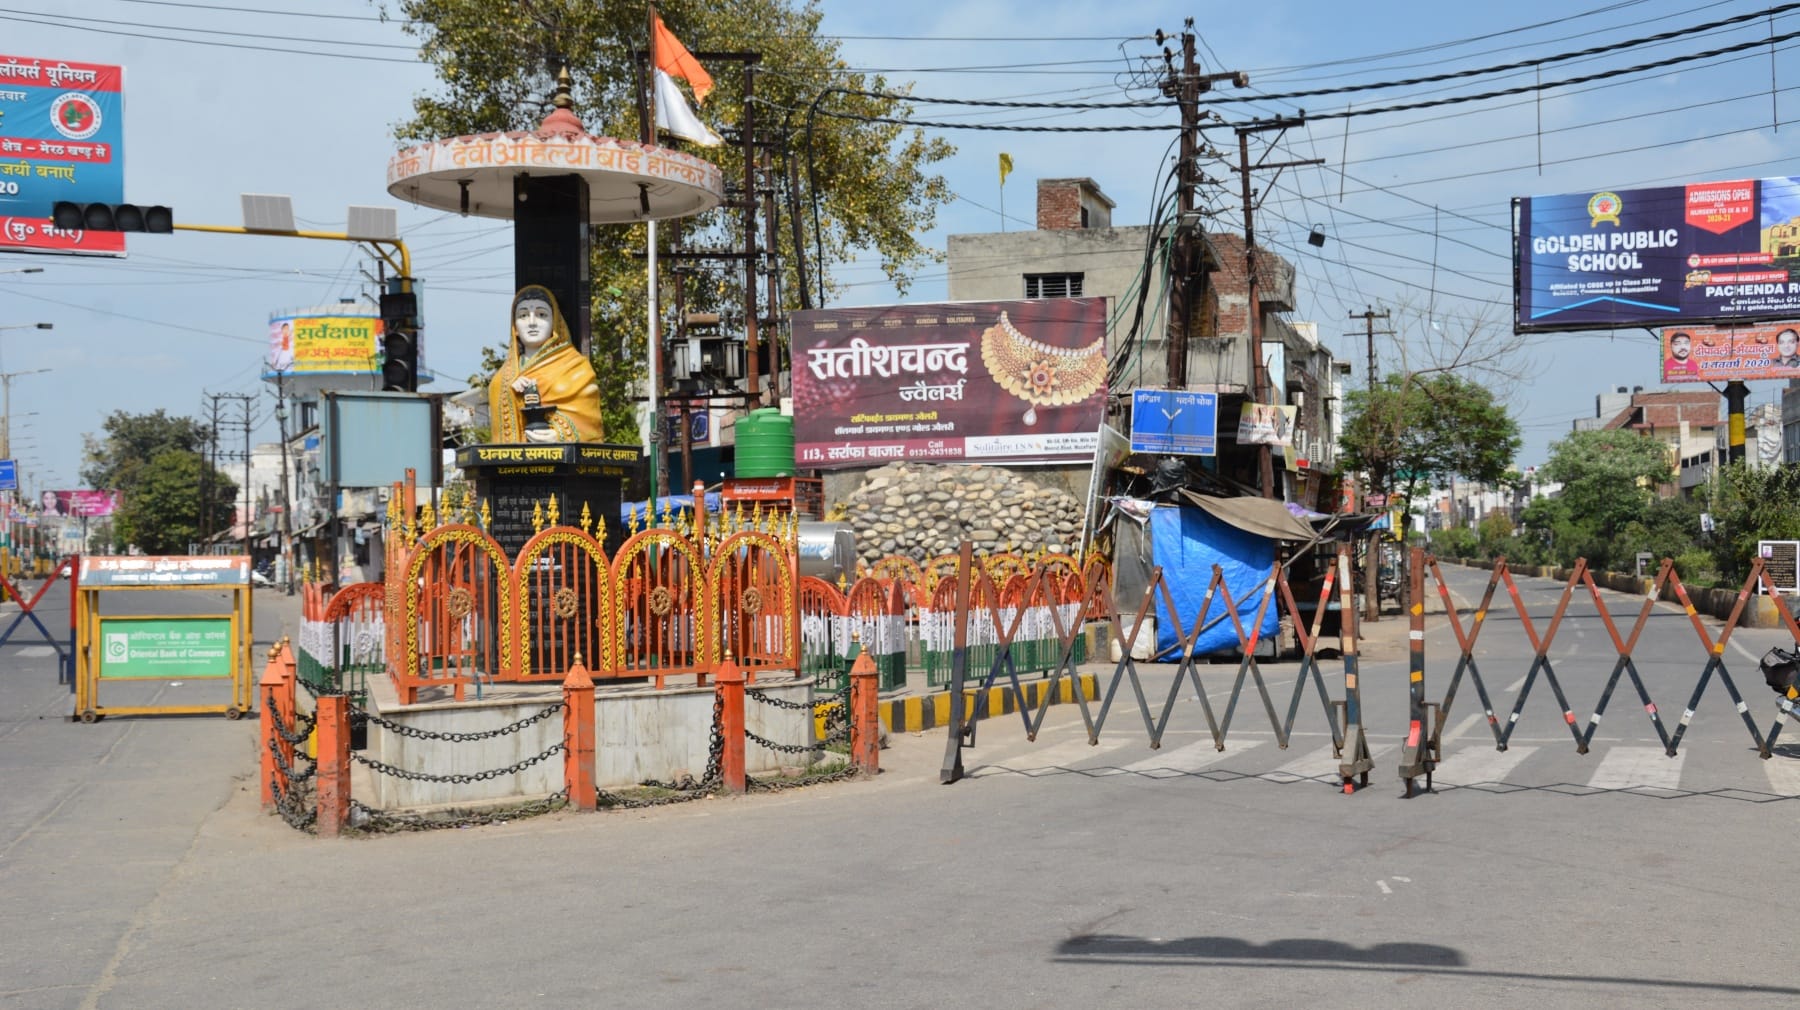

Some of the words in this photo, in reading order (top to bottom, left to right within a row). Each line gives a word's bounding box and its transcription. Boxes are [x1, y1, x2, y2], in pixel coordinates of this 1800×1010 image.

[46, 63, 97, 86] यूनियन
[36, 164, 76, 183] बनाएं
[1689, 190, 1731, 203] ADMISSIONS
[1732, 188, 1751, 200] OPEN
[1533, 234, 1606, 254] GOLDEN
[1610, 229, 1678, 250] PUBLIC
[1567, 252, 1643, 272] SCHOOL
[297, 323, 370, 340] सर्वेक्षण
[808, 338, 970, 380] सतीशचन्द
[1744, 359, 1771, 368] 2020
[899, 379, 966, 401] ज्वैलर्स
[479, 447, 523, 461] धनगर
[525, 447, 564, 460] समाज
[581, 447, 610, 460] धनगर
[612, 449, 638, 462] समाज
[804, 448, 824, 461] 113,
[868, 446, 905, 458] बाजार
[130, 649, 159, 658] Oriental
[160, 649, 178, 658] Bank
[179, 649, 188, 657] of
[188, 649, 226, 657] Commerce
